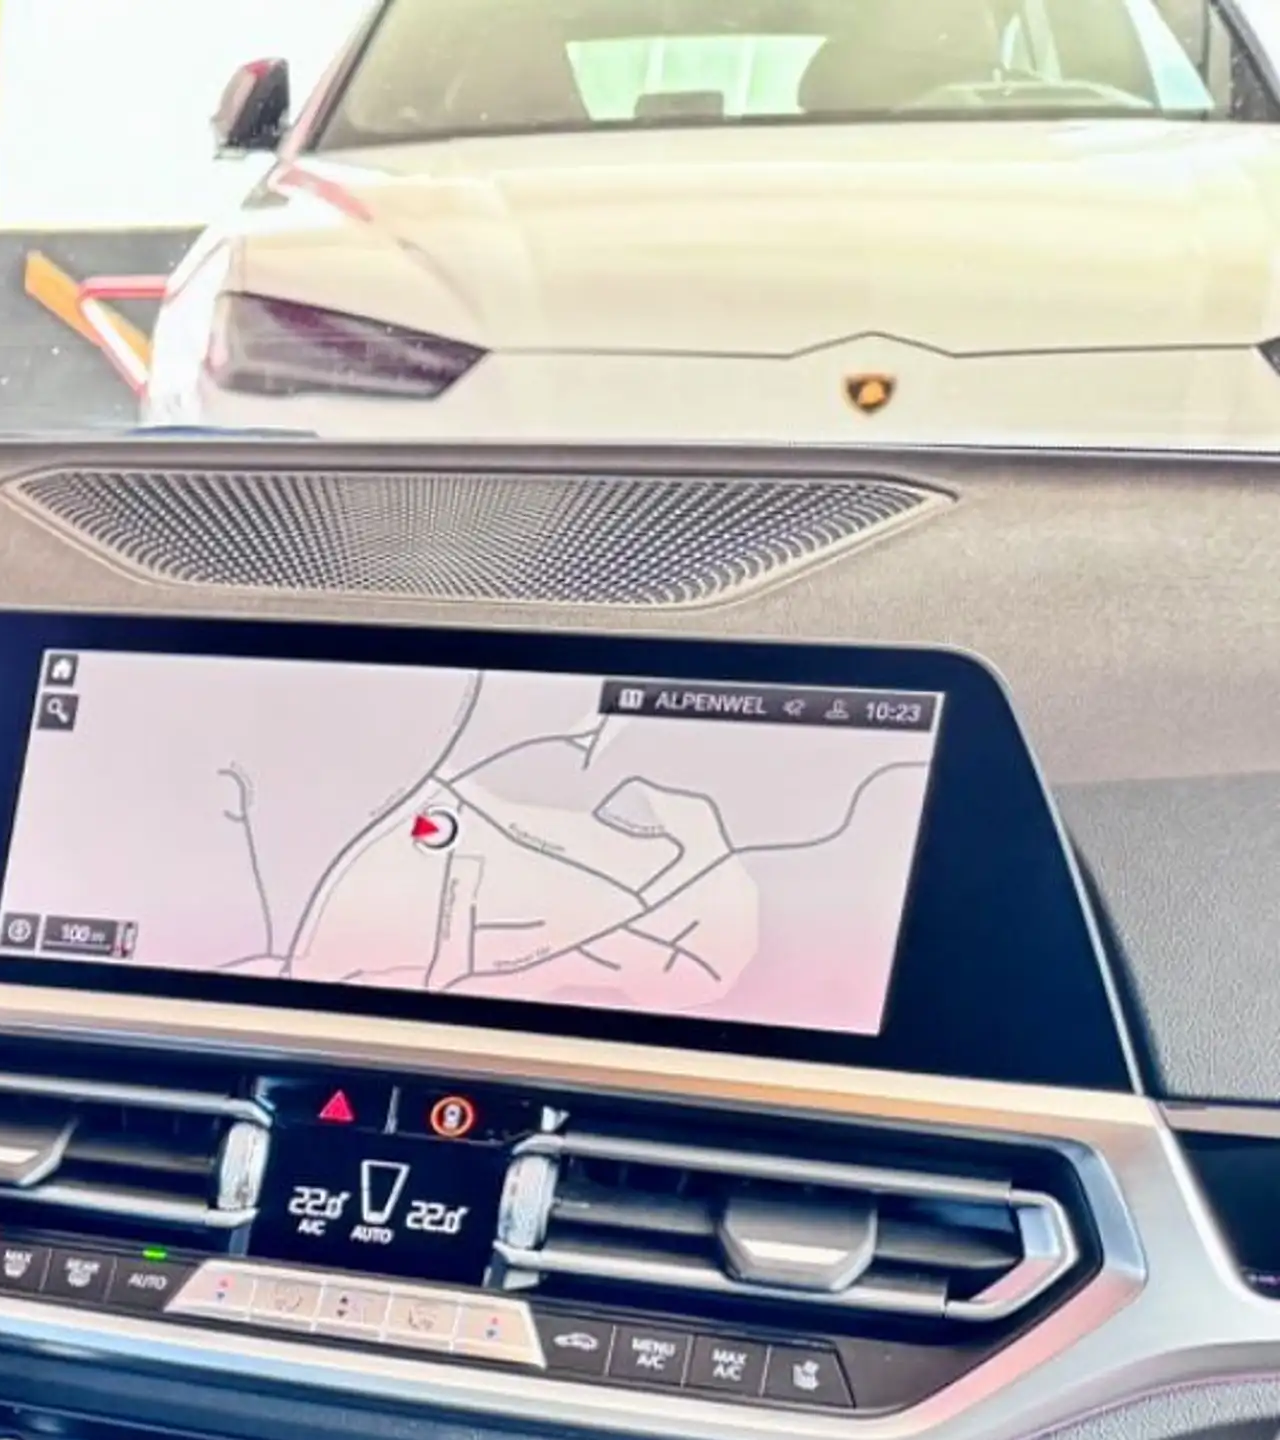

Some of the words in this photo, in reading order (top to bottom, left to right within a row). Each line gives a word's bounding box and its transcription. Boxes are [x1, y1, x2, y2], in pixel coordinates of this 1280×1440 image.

[655, 690, 768, 715] ALPENWEL
[864, 700, 922, 723] 10:23
[349, 1224, 395, 1244] AUTO
[127, 1272, 169, 1291] AUTO
